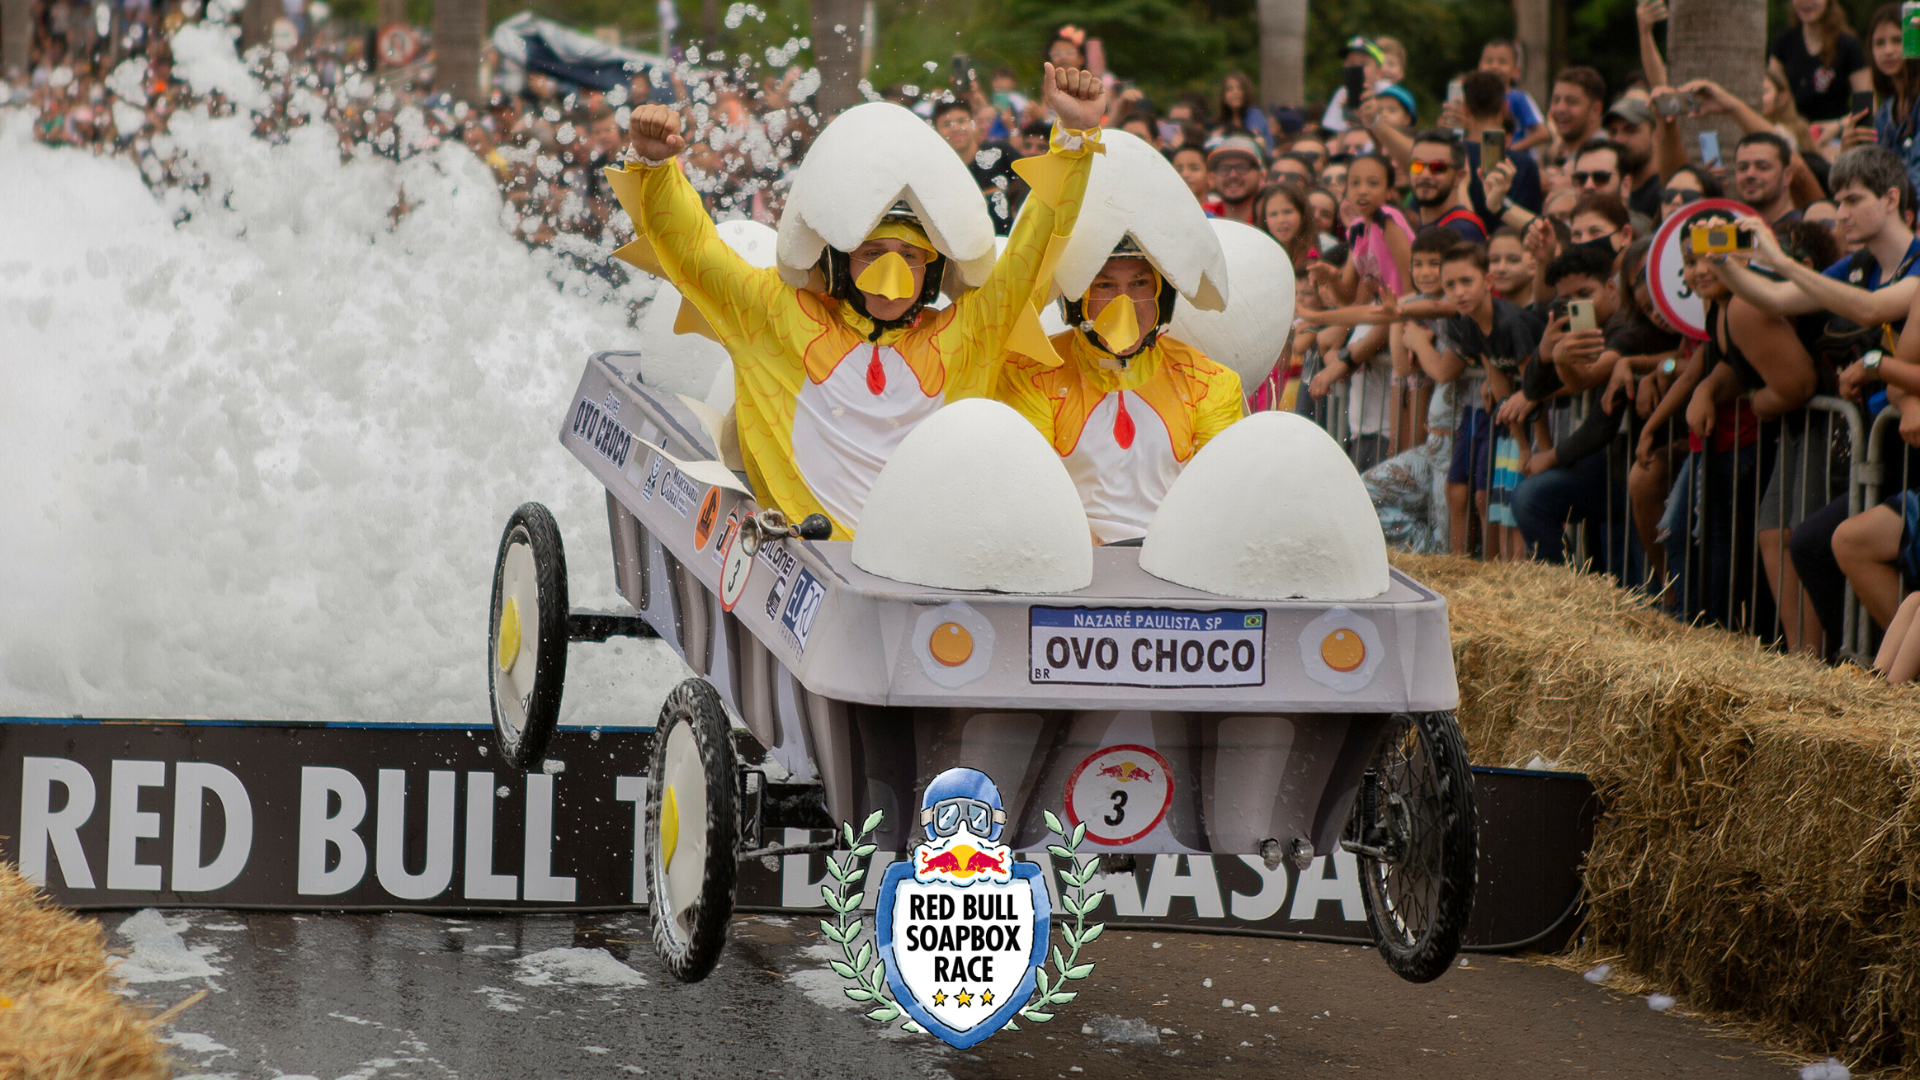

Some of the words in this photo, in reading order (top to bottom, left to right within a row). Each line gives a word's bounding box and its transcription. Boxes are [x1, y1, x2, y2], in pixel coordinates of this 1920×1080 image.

[573, 397, 601, 443] OVO
[594, 412, 632, 470] CHOCO
[728, 559, 741, 593] 3
[785, 574, 821, 637] EURO
[1073, 611, 1131, 628] NAZARÉ
[1136, 615, 1200, 630] PAULISTA
[1205, 616, 1222, 630] SP
[1045, 636, 1119, 671] OVO
[1131, 637, 1255, 673] CHOCO
[1034, 668, 1050, 679] BR
[1104, 790, 1128, 826] 3
[19, 756, 253, 892] RED
[298, 766, 576, 902] BULL
